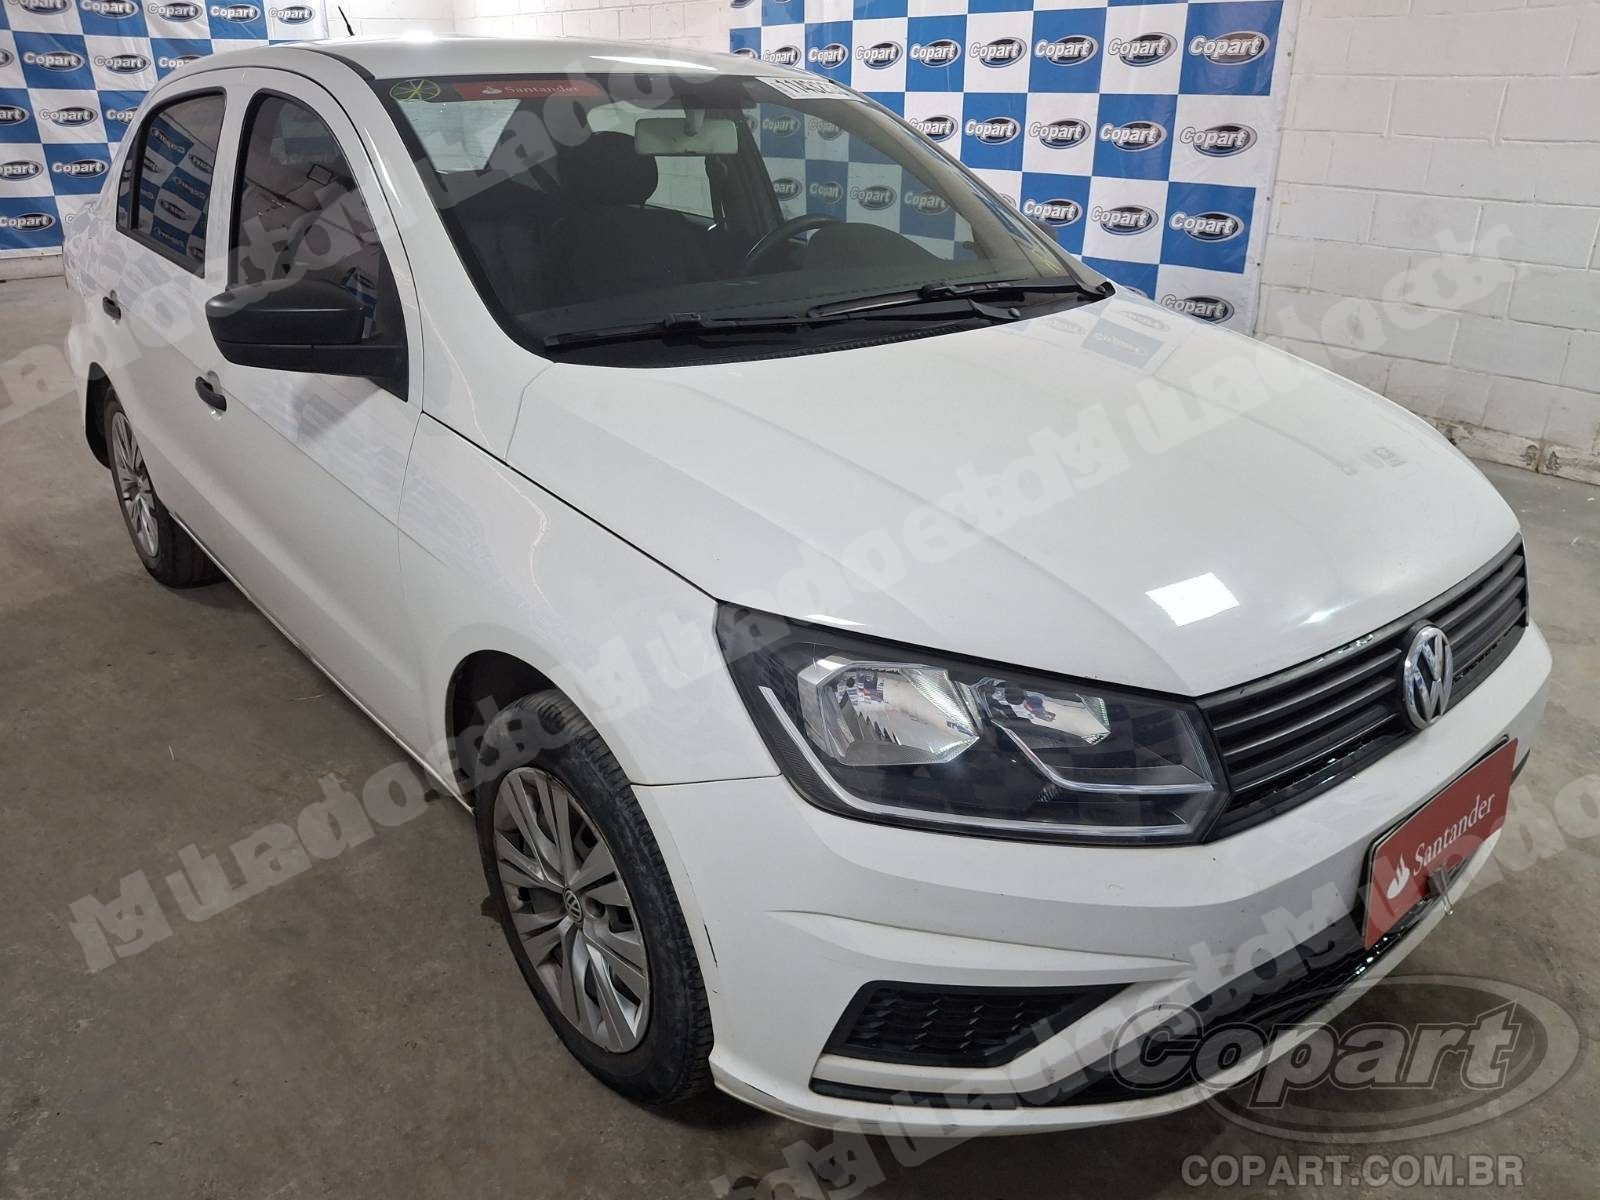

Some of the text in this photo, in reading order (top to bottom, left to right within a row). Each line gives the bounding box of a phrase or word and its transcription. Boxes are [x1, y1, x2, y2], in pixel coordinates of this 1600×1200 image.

[81, 0, 133, 14] Copart
[148, 3, 196, 16] Copart
[210, 5, 256, 18] Copart
[269, 7, 310, 19] Copart
[807, 46, 843, 66] Copart
[855, 43, 897, 63] Copart
[910, 42, 955, 64] Copart
[970, 41, 1019, 64] Copart
[1034, 39, 1094, 61] Copart
[1108, 37, 1168, 60] Copart
[1189, 35, 1261, 60] Copart
[23, 51, 77, 67] Copart
[94, 55, 143, 69] Copart
[504, 85, 580, 94] Santander
[39, 108, 91, 121] Copart
[965, 119, 1016, 140] Copart
[1029, 122, 1086, 146] Copart
[1100, 123, 1162, 149] Copart
[1180, 127, 1250, 151] Copart
[0, 163, 36, 177] part
[52, 161, 102, 175] Copart
[849, 186, 891, 204] Copart
[1023, 198, 1077, 222] Copart
[1091, 205, 1150, 231] Copart
[0, 214, 48, 229] Copart
[1169, 210, 1236, 236] Copart
[1161, 293, 1226, 318] Copart
[1413, 793, 1495, 876] Santander
